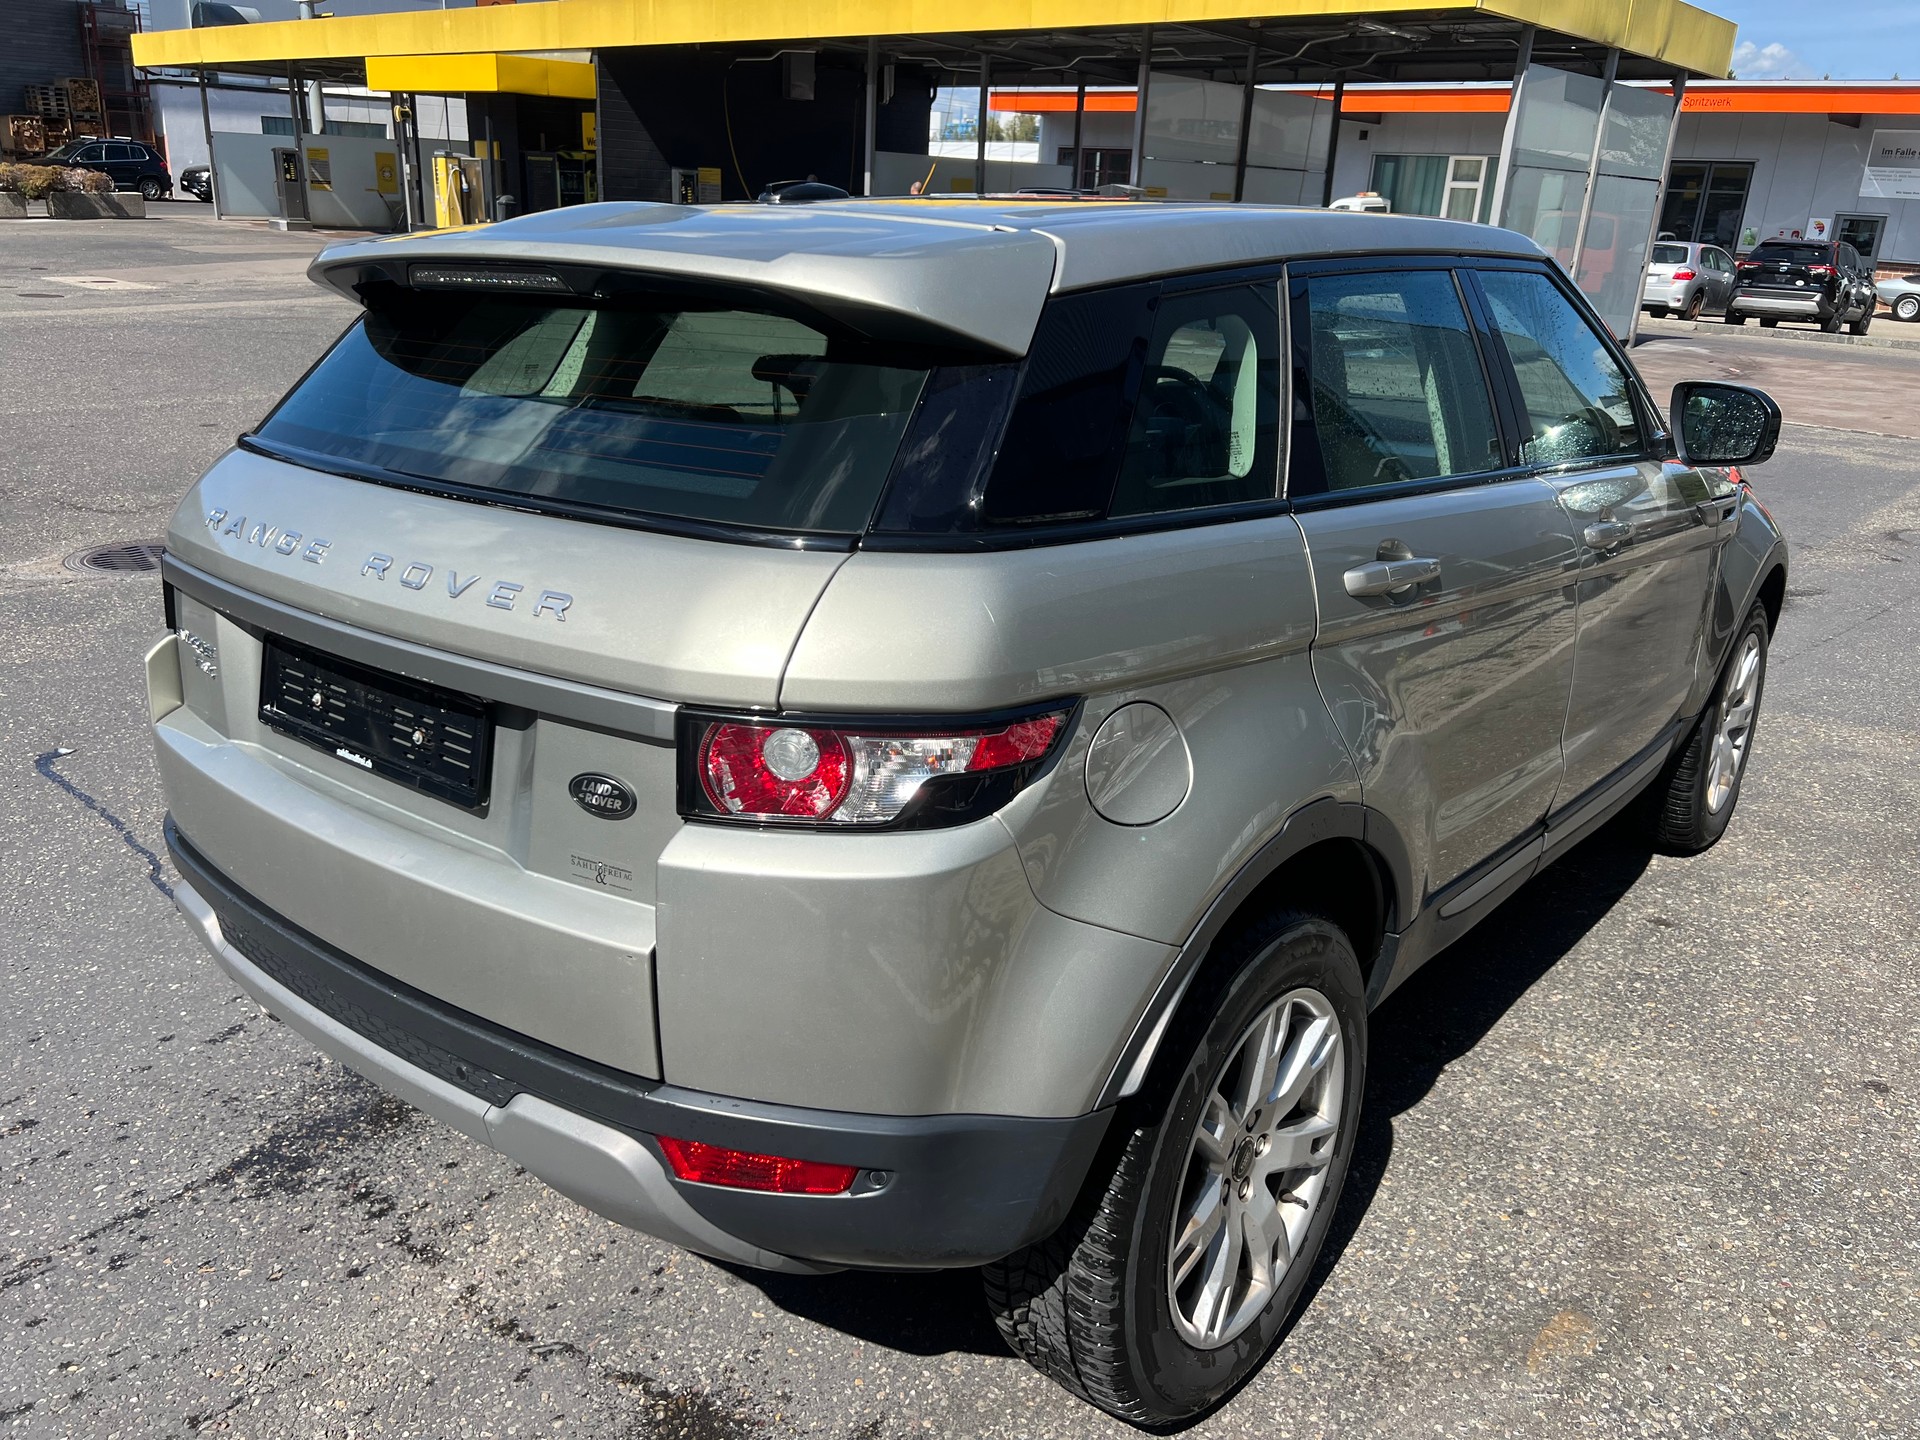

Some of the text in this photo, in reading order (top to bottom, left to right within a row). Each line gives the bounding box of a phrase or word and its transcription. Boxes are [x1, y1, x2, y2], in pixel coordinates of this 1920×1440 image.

[1683, 96, 1732, 108] Spritzwerk
[1881, 147, 1893, 156] Im
[1895, 147, 1917, 157] Falle
[205, 506, 574, 622] RANGE ROVER
[581, 780, 612, 796] LAND
[584, 793, 623, 810] ROVER
[570, 858, 598, 872] SAHLI
[603, 866, 622, 879] FREI
[623, 872, 633, 881] AG
